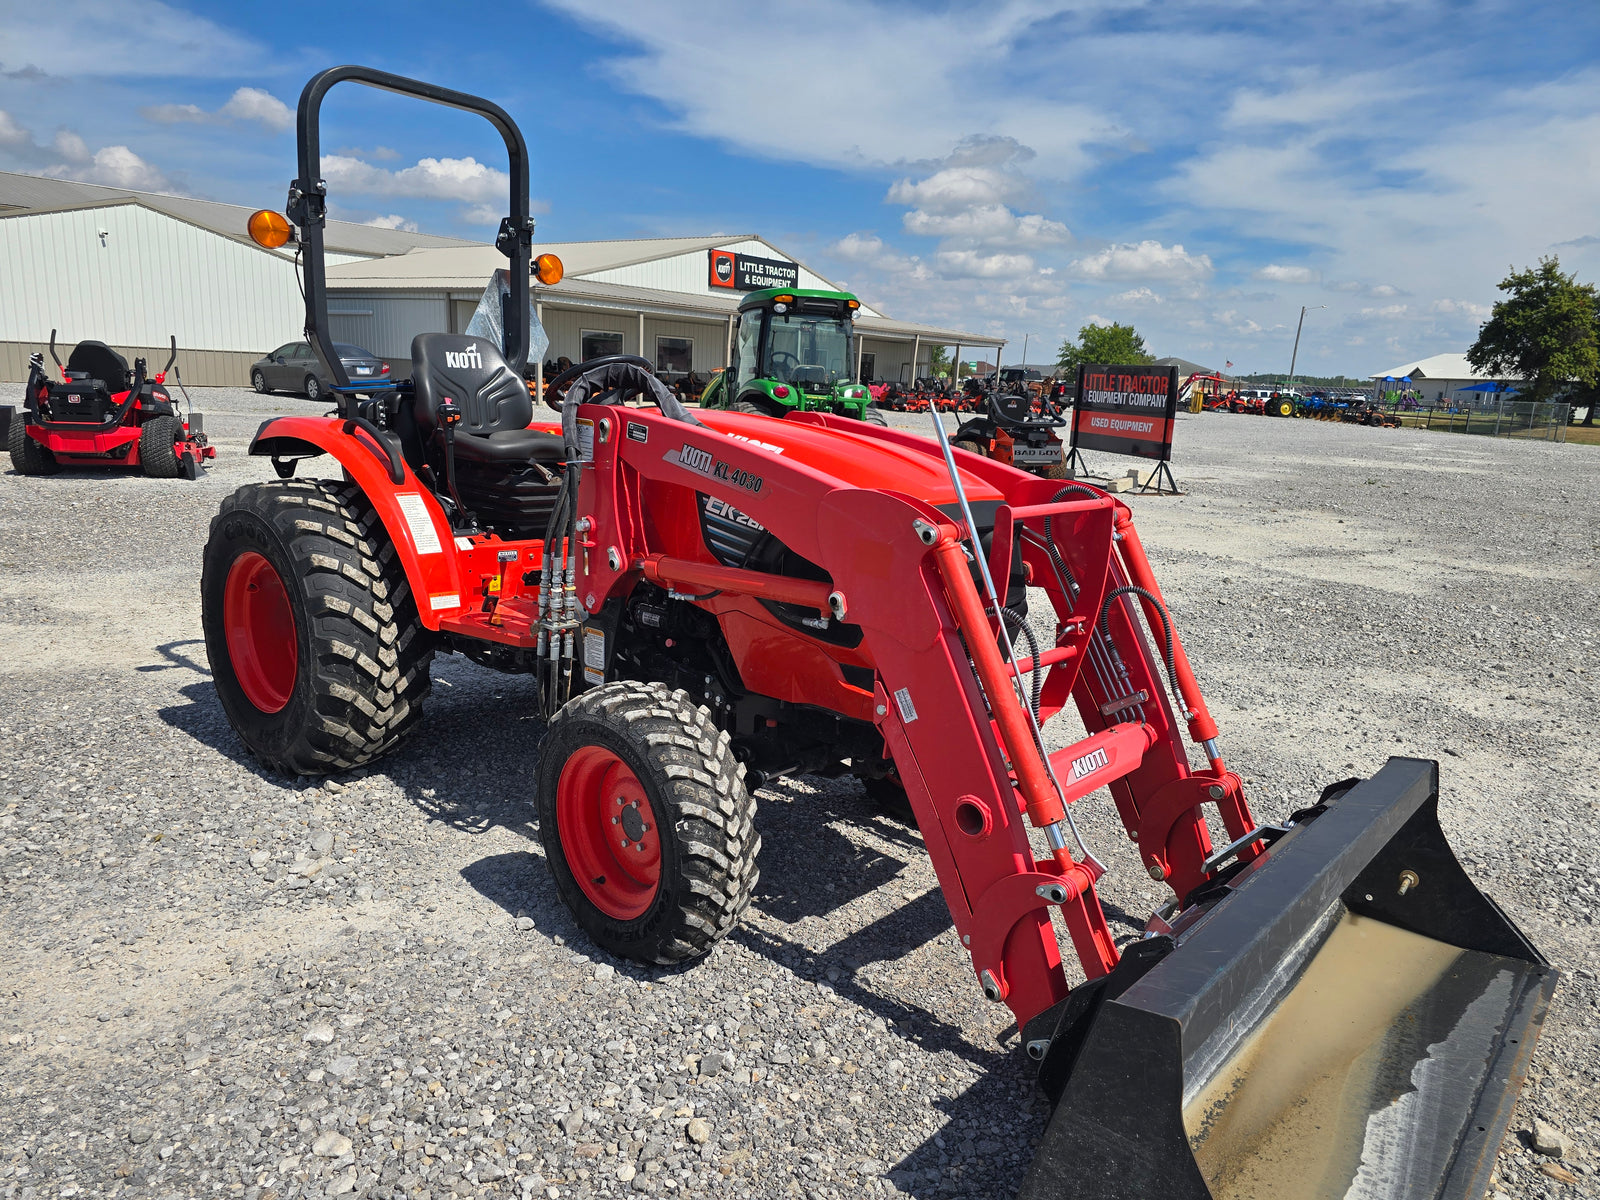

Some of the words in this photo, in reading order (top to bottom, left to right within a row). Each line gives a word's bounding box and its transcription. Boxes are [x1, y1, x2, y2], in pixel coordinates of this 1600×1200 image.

[740, 261, 764, 274] LITTLE
[765, 265, 796, 279] TRACTOR
[744, 274, 751, 284] &
[751, 275, 792, 288] EQUIPMENT
[445, 351, 483, 369] KIOTI
[1083, 373, 1116, 391] LITTLE
[1118, 374, 1169, 394] TRACTOR
[1088, 390, 1128, 405] EQUIPMENT
[1128, 393, 1168, 408] COMPANY
[1091, 417, 1109, 428] USED
[1110, 419, 1154, 433] EQUIPMENT
[679, 442, 713, 474] KIOTI
[713, 460, 730, 481] KL
[730, 468, 763, 493] 4030
[1071, 746, 1110, 779] KIOTI
